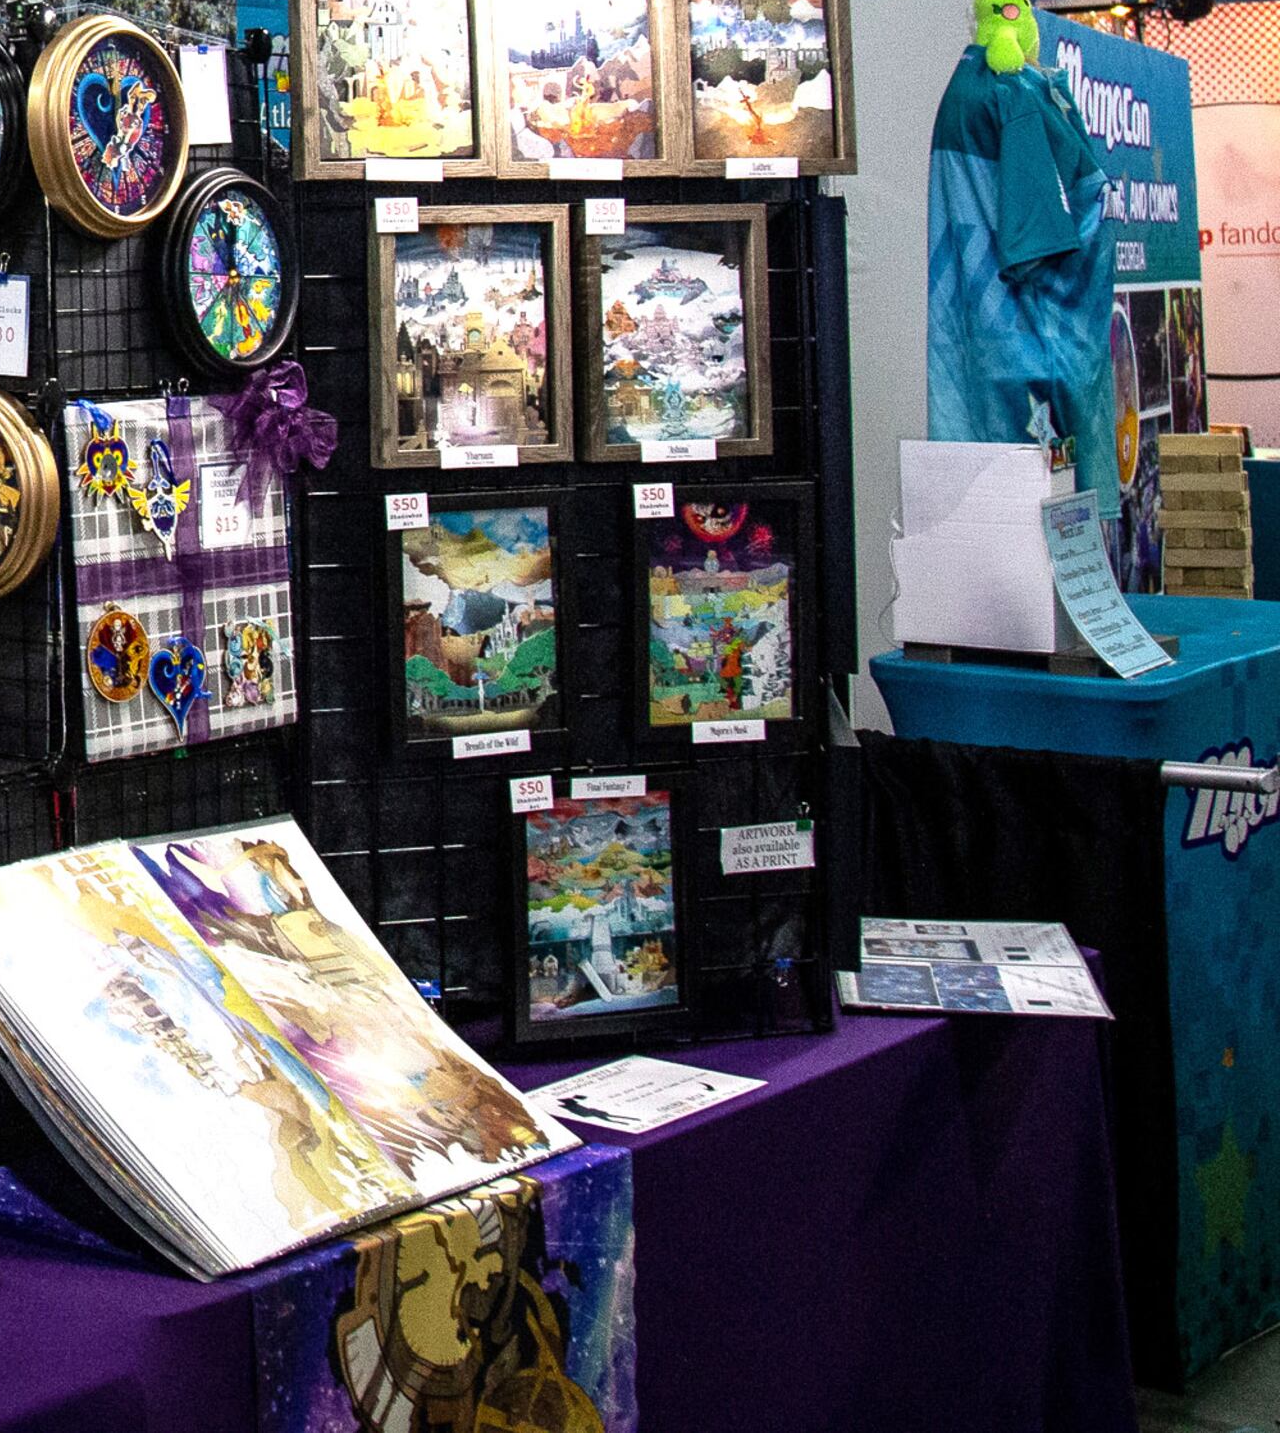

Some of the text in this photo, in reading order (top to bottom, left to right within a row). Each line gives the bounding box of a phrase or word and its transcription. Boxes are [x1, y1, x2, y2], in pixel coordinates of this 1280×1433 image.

[385, 202, 410, 216] $50
[594, 202, 618, 215] $50
[1130, 179, 1148, 220] AND
[1148, 181, 1179, 224] COMICS
[641, 488, 666, 502] $50
[392, 497, 419, 512] $50
[215, 515, 239, 536] $15
[519, 780, 544, 796] $50
[736, 823, 795, 841] ARTWORK
[732, 838, 801, 856] also available
[734, 853, 799, 869] AS A PRINT
